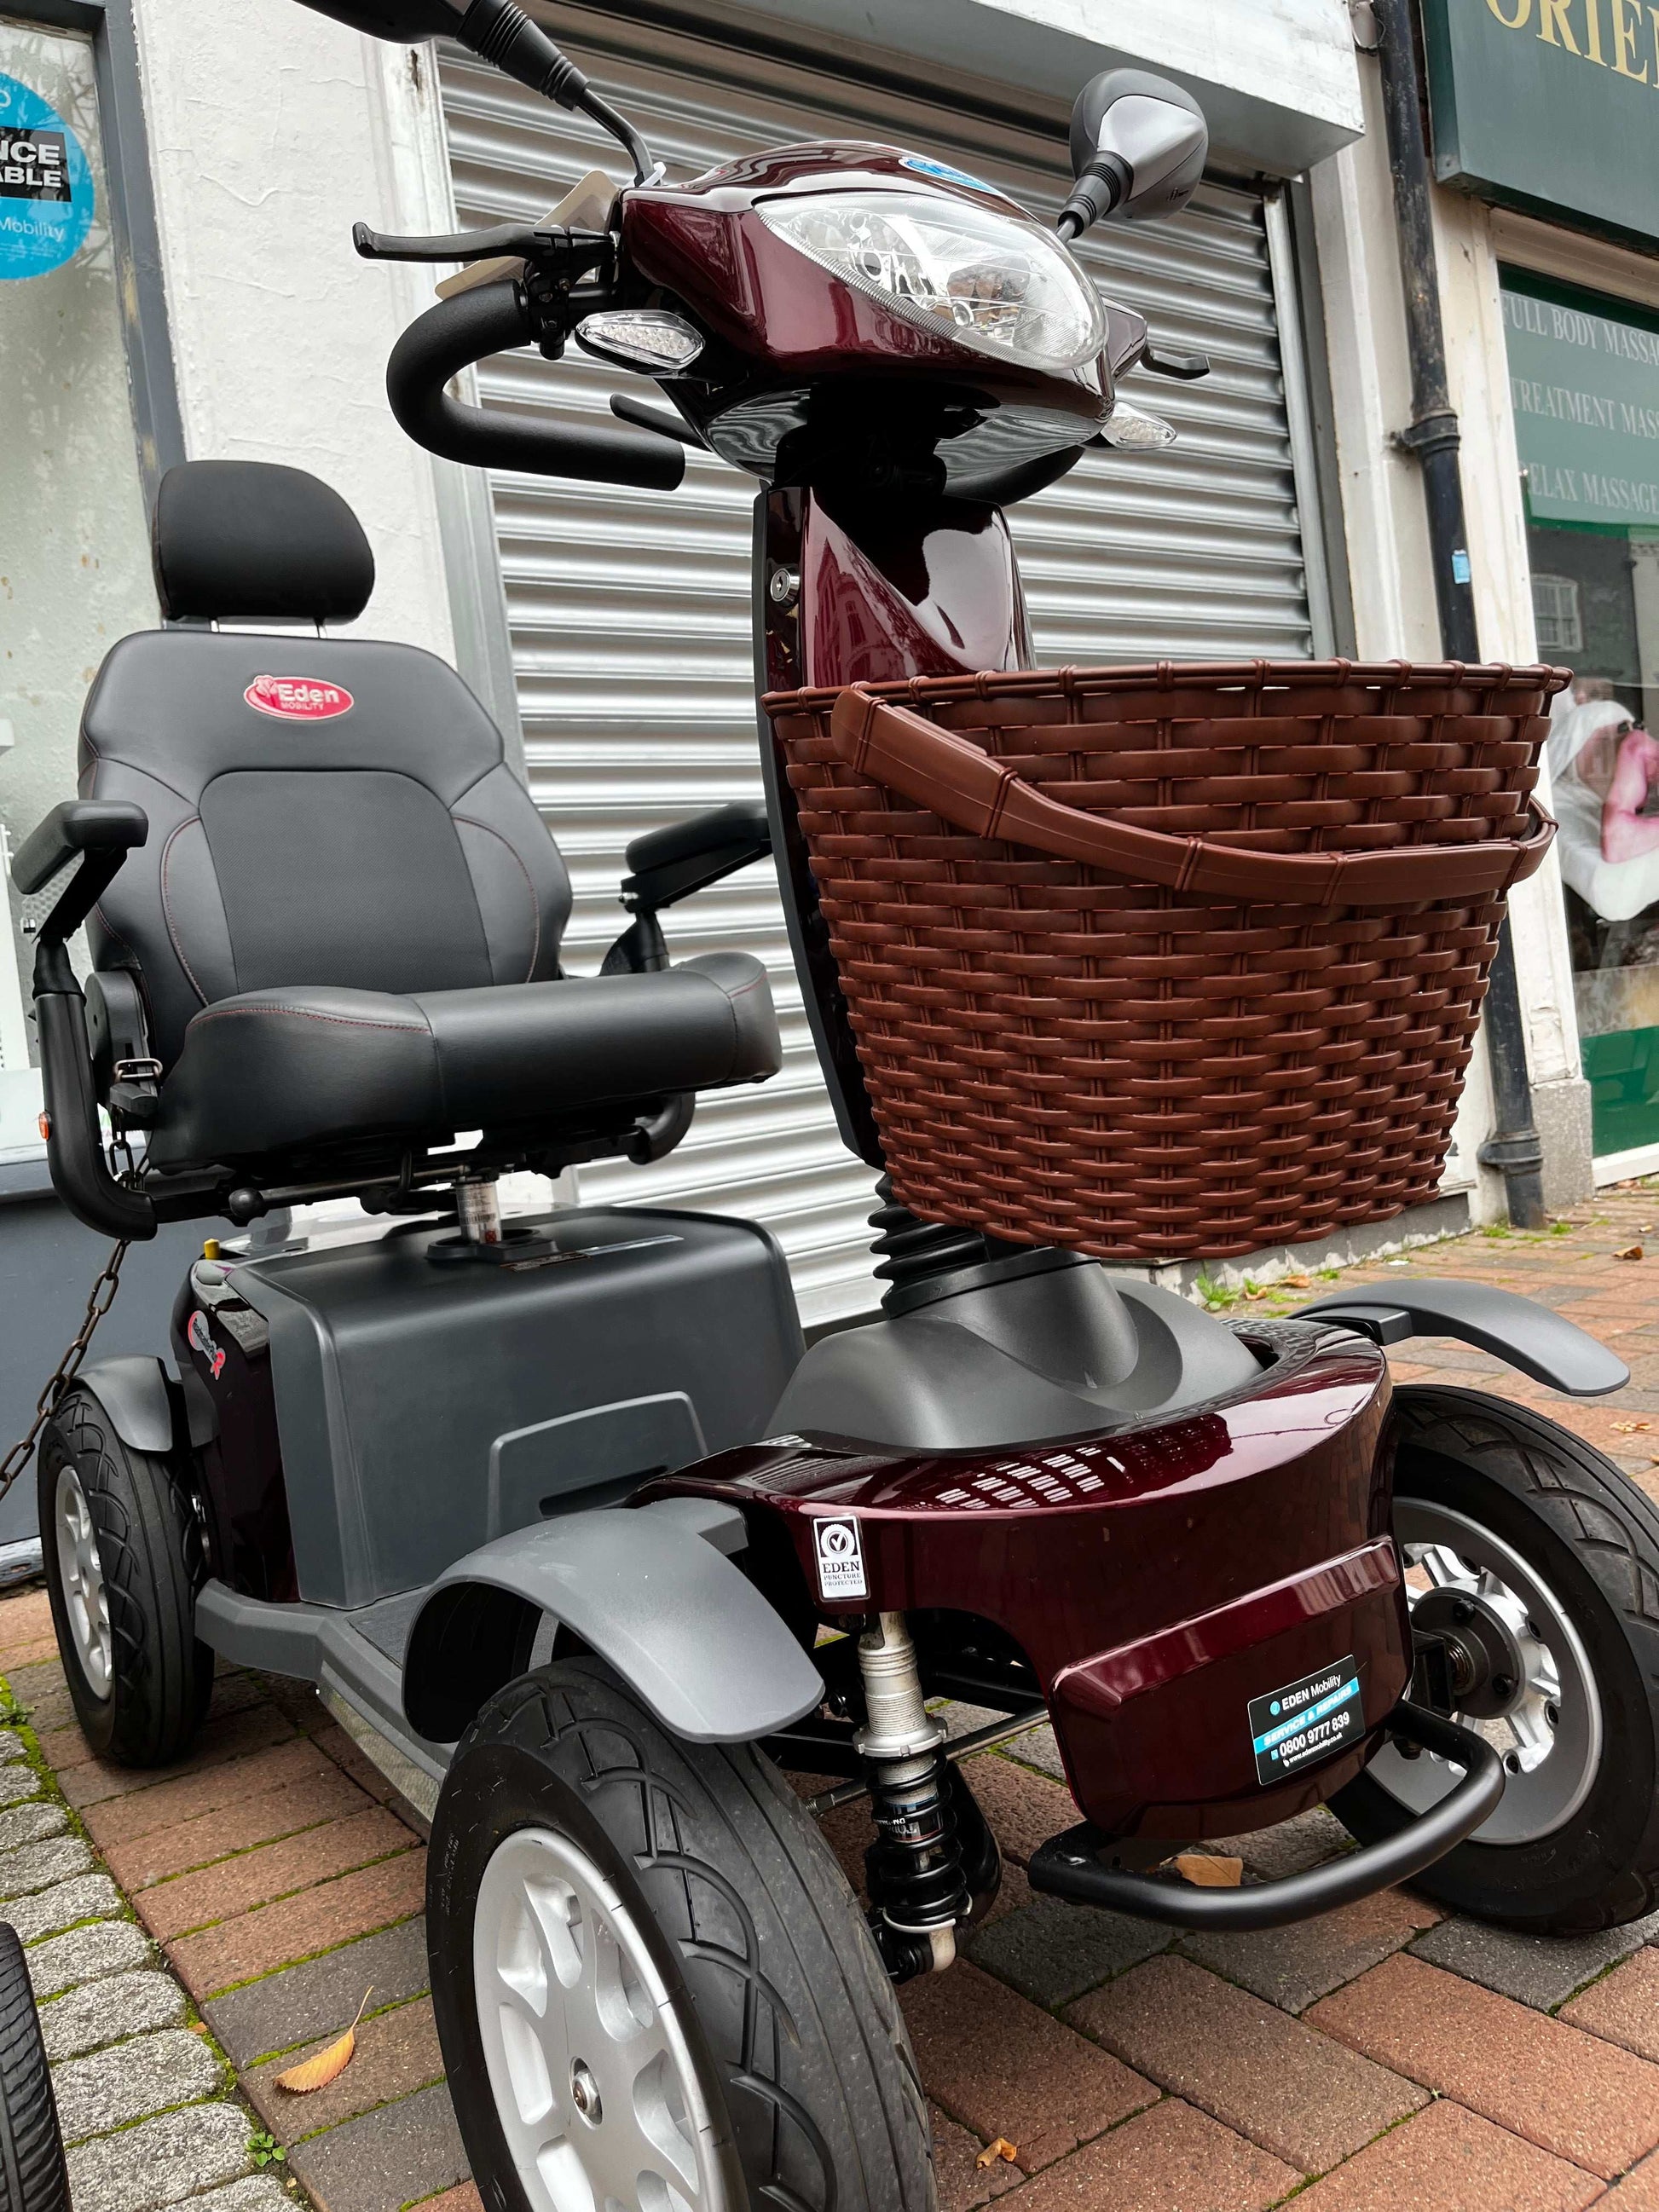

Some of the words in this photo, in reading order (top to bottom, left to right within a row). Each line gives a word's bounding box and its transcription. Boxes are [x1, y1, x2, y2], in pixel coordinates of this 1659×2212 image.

[1551, 308, 1597, 349] BODY
[1603, 322, 1659, 366] MASSA
[1510, 377, 1615, 430] TREATMENT
[1521, 462, 1578, 501] ELAX
[1582, 471, 1659, 515] MASSAGE
[278, 684, 339, 702] Eden
[280, 702, 324, 710] MOBILITY
[822, 1561, 859, 1573] EDEN
[1281, 1689, 1309, 1711] EDEN
[1311, 1674, 1341, 1697] Mobility
[1263, 1714, 1306, 1746] SERVICE
[1307, 1710, 1315, 1721] &
[1316, 1685, 1352, 1716] REPAIRS
[1279, 1734, 1306, 1757] 0800
[1307, 1721, 1331, 1744] 9777
[1332, 1711, 1350, 1731] 839
[1289, 1732, 1344, 1764] www.edenmobility.co.uk
